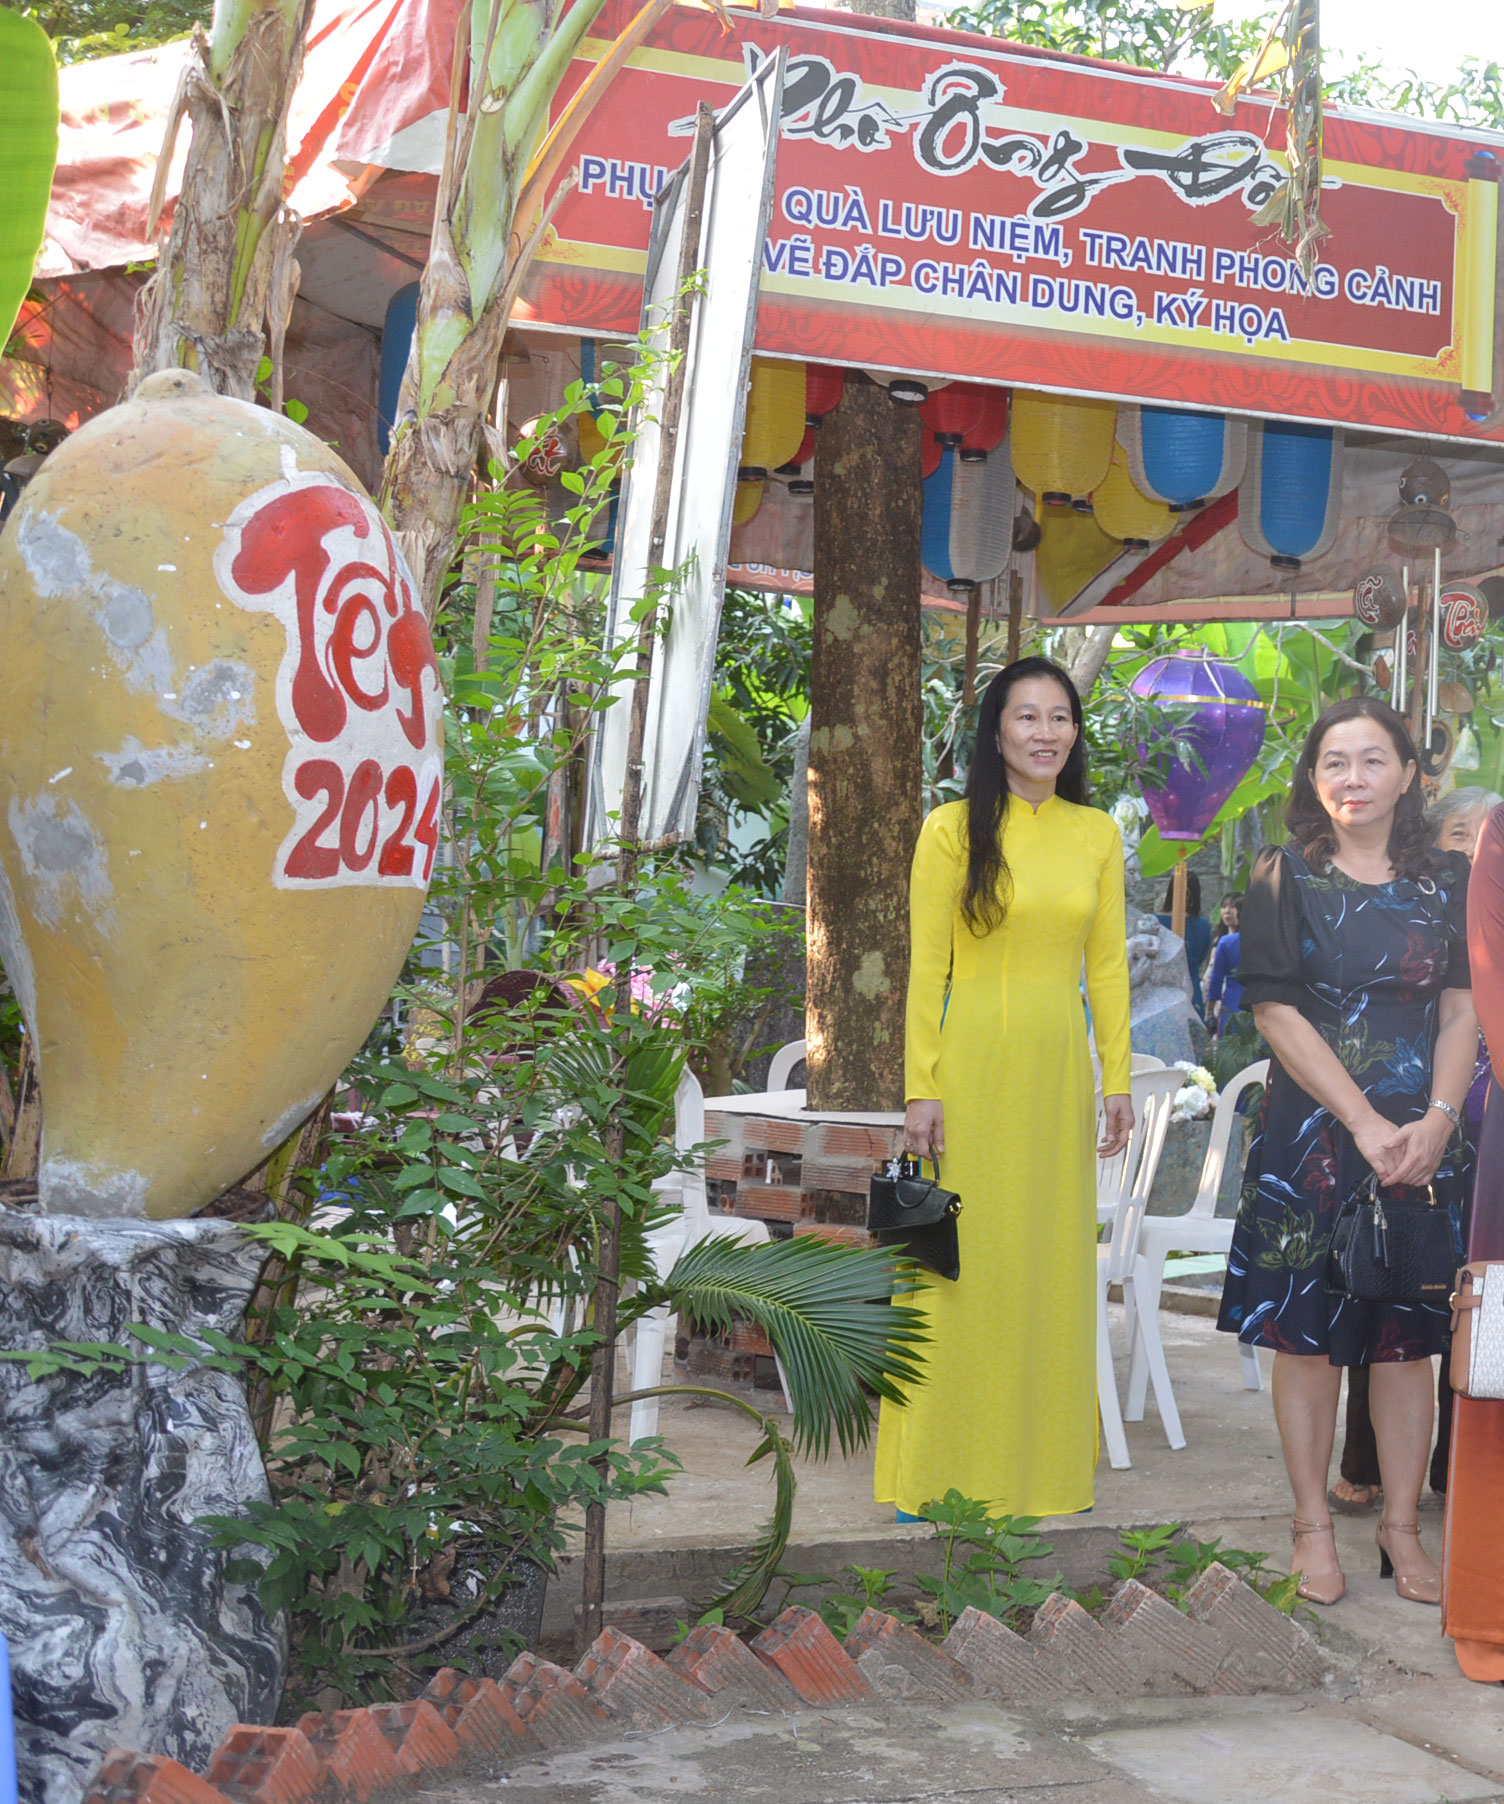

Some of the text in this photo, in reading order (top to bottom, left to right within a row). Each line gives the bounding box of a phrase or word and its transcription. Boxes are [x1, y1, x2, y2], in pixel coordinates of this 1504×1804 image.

[919, 68, 1098, 218] Ông
[581, 157, 1440, 313] PHỤ QUÀ LƯU NIỆM, TRANH PHONG CẢNH
[764, 237, 1289, 344] VẼ ĐẮP CHÂN DUNG, KÝ HỌA
[283, 757, 440, 884] 2024
